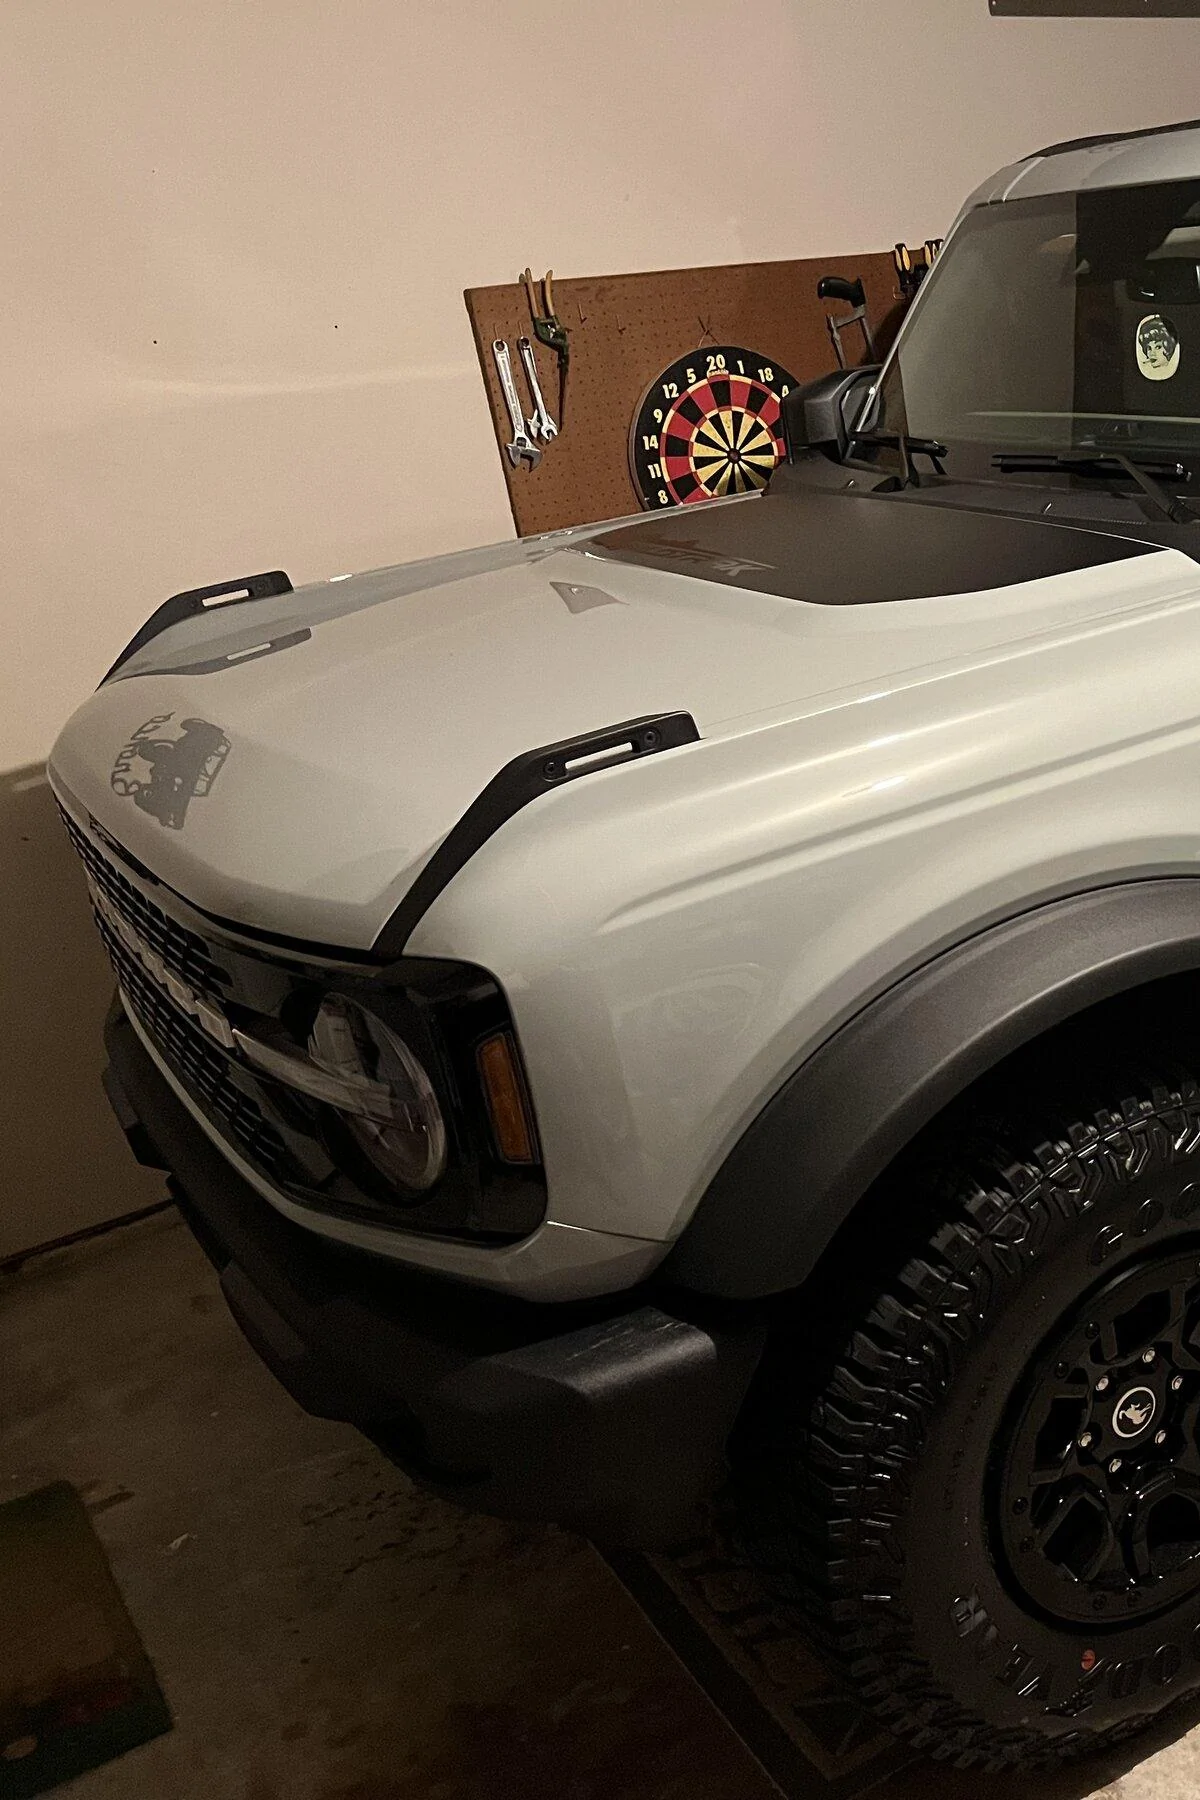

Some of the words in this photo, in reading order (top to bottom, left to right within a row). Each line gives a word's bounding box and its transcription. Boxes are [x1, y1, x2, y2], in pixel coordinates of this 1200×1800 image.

[706, 354, 726, 370] 20
[737, 360, 745, 374] 1
[686, 368, 697, 384] 5
[758, 367, 774, 383] 18
[662, 383, 680, 399] 12
[653, 408, 663, 424] 9
[642, 435, 659, 451] 14
[647, 463, 661, 479] 11
[657, 489, 669, 505] 8
